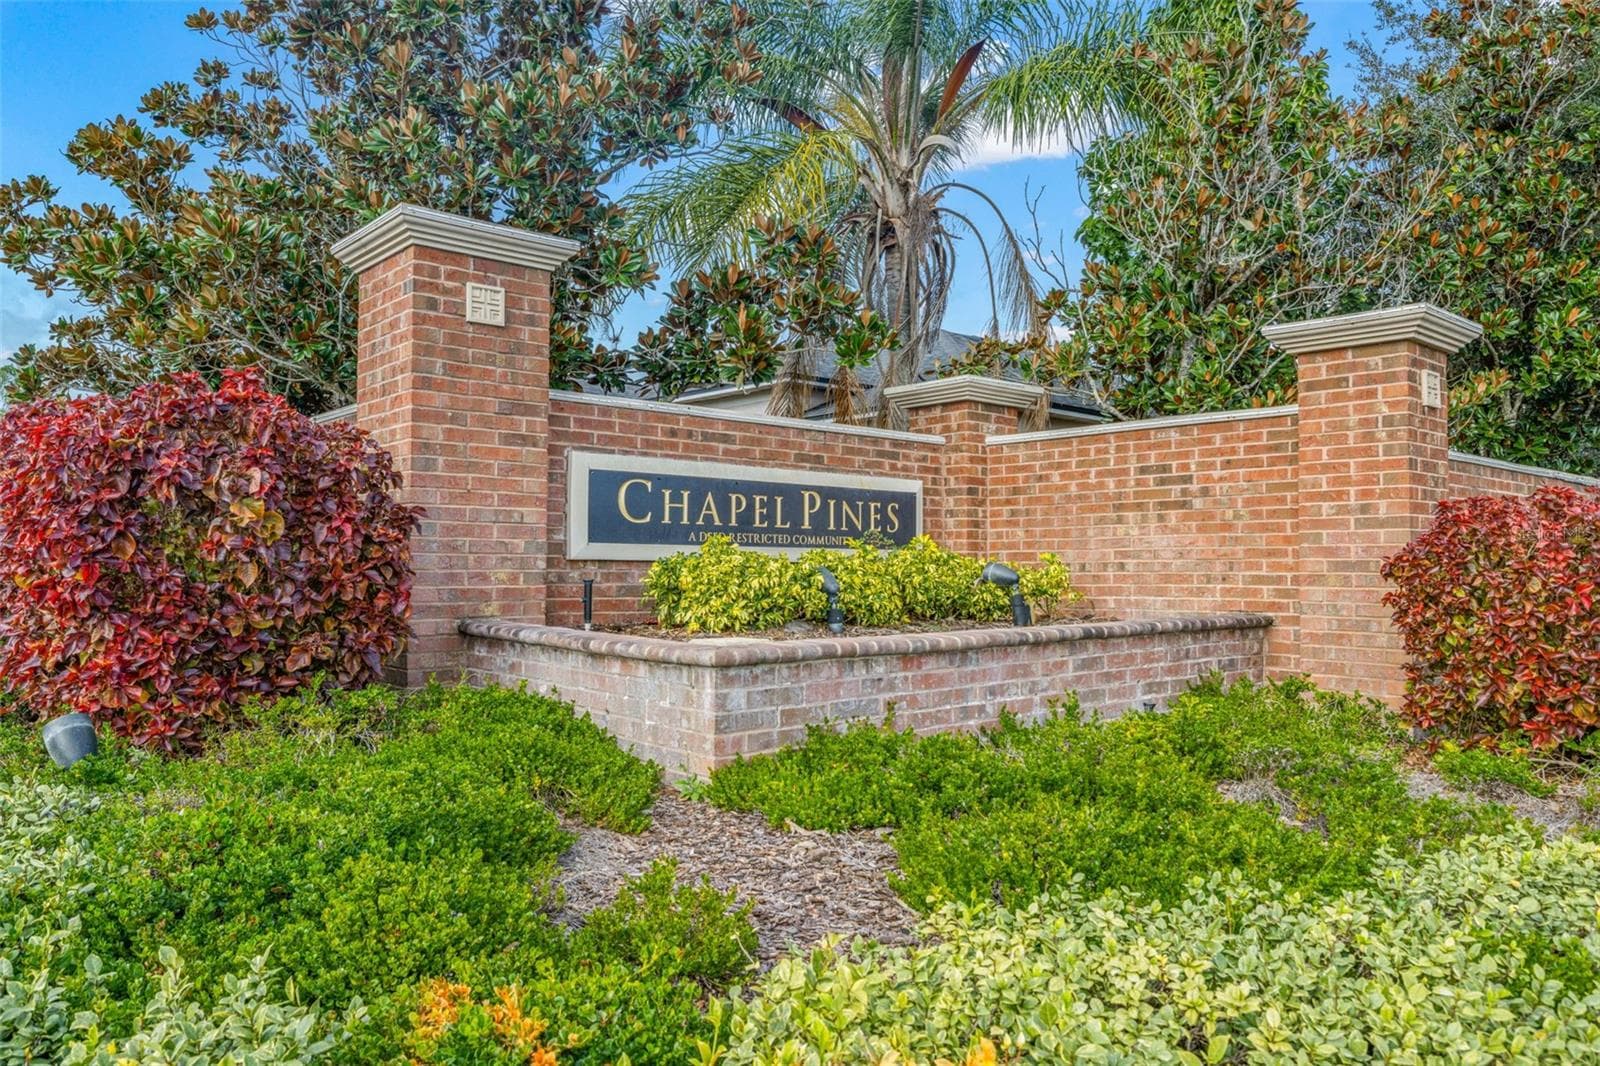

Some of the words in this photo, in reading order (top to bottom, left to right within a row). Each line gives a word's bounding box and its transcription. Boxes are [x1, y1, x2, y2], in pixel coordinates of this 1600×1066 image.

[617, 478, 790, 528] CHAPEL
[800, 490, 900, 533] PINES
[688, 531, 697, 542] A
[729, 532, 790, 545] RESTRICTED
[793, 535, 850, 545] COMMUNIT
